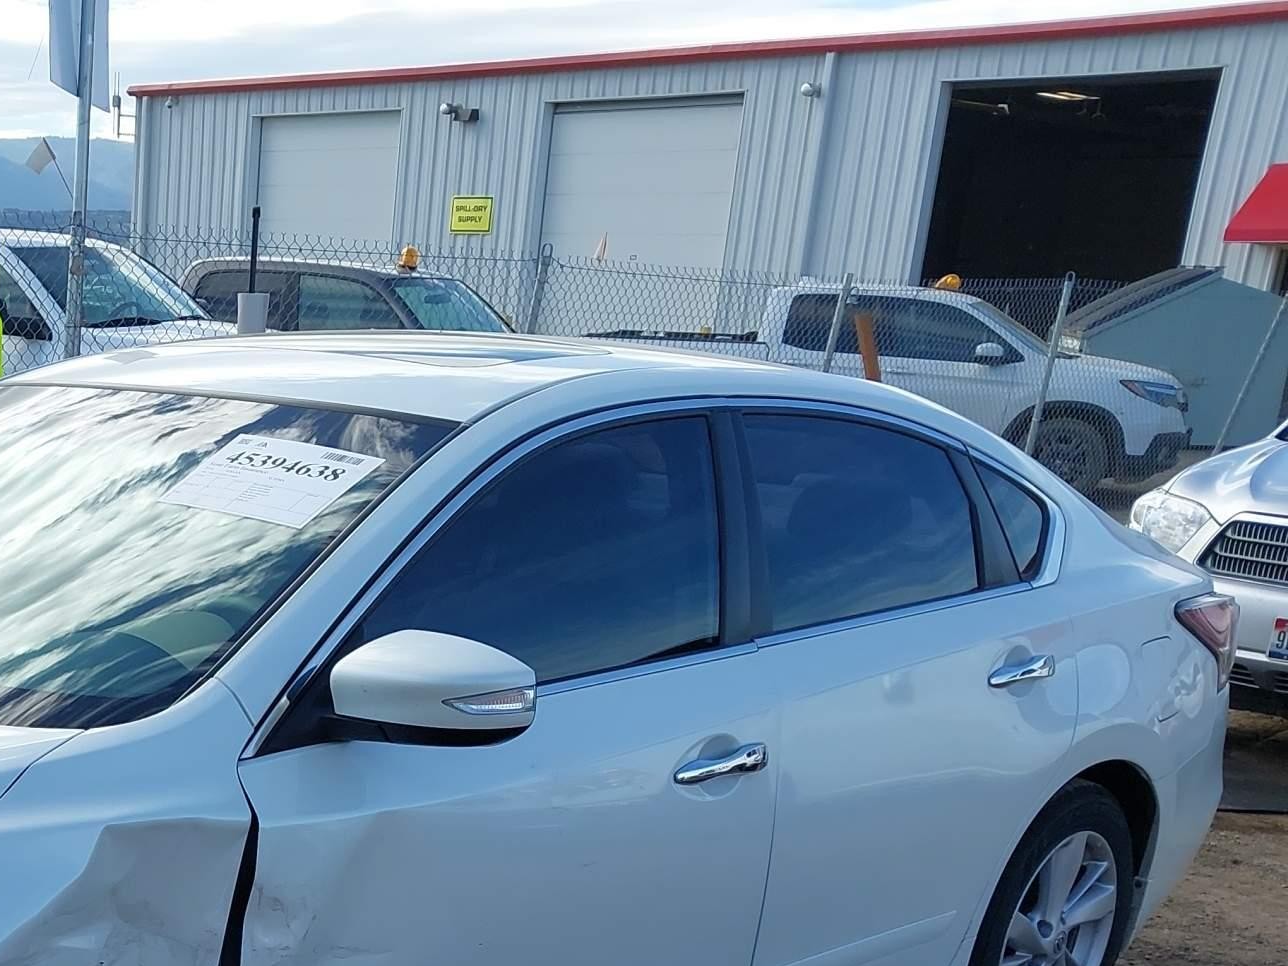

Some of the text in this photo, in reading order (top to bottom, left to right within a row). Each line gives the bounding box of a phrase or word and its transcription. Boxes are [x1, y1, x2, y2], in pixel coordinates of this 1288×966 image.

[457, 215, 483, 223] SUPPLY
[225, 451, 347, 482] 45394638
[1275, 630, 1288, 650] 9
